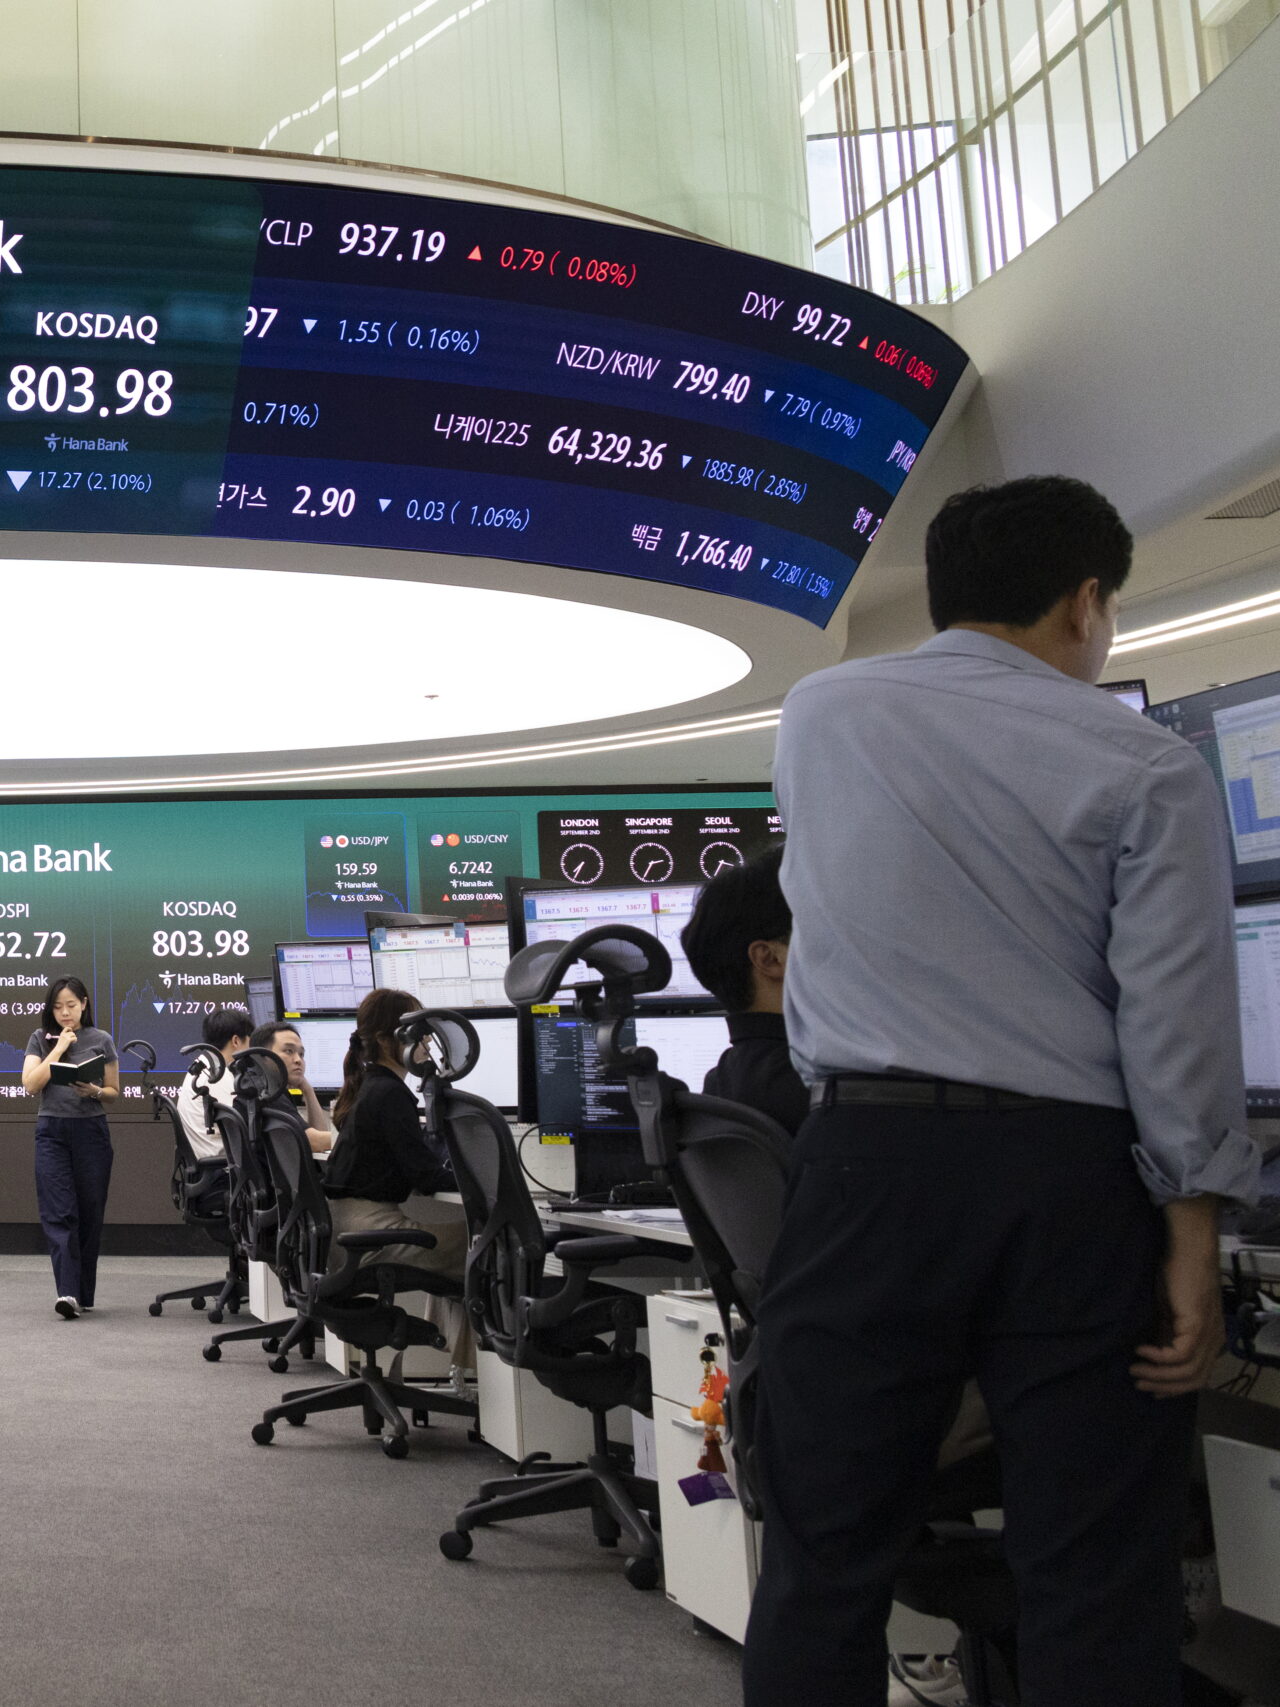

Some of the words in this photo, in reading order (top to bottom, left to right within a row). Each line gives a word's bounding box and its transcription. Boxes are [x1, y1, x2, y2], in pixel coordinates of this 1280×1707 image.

[338, 222, 446, 262] 937.19
[742, 291, 784, 321] DXY
[792, 304, 851, 347] 99.72
[35, 311, 158, 345] KOSDAQ
[557, 342, 661, 381] NZD/KRW
[673, 361, 751, 404] 799.40
[6, 364, 173, 418] 803.98
[62, 436, 95, 451] Hana
[97, 439, 128, 452] Bank
[434, 413, 532, 447] 니케이225
[548, 426, 667, 470] 64,329.36
[39, 471, 82, 489] 17.27
[87, 472, 152, 492] (2.10%)
[292, 485, 356, 518] 2.90
[631, 524, 662, 552] 백금
[675, 531, 752, 571] 1,766.40
[561, 819, 598, 827] LONDON
[626, 818, 672, 826] SINGAPORE
[352, 836, 389, 846] USD/JPY
[465, 835, 508, 843] USD/CNY
[34, 842, 112, 872] Bank
[335, 863, 377, 876] 159.59
[449, 861, 492, 874] 6.7242
[357, 894, 383, 902] (0.35%)
[476, 893, 503, 901] (0.06%)
[163, 901, 237, 918] KOSDAQ
[153, 930, 249, 959] 803.98
[17, 974, 48, 986] Bank
[178, 974, 211, 985] Hana
[213, 973, 245, 985] Bank
[168, 1002, 200, 1014] 17.27
